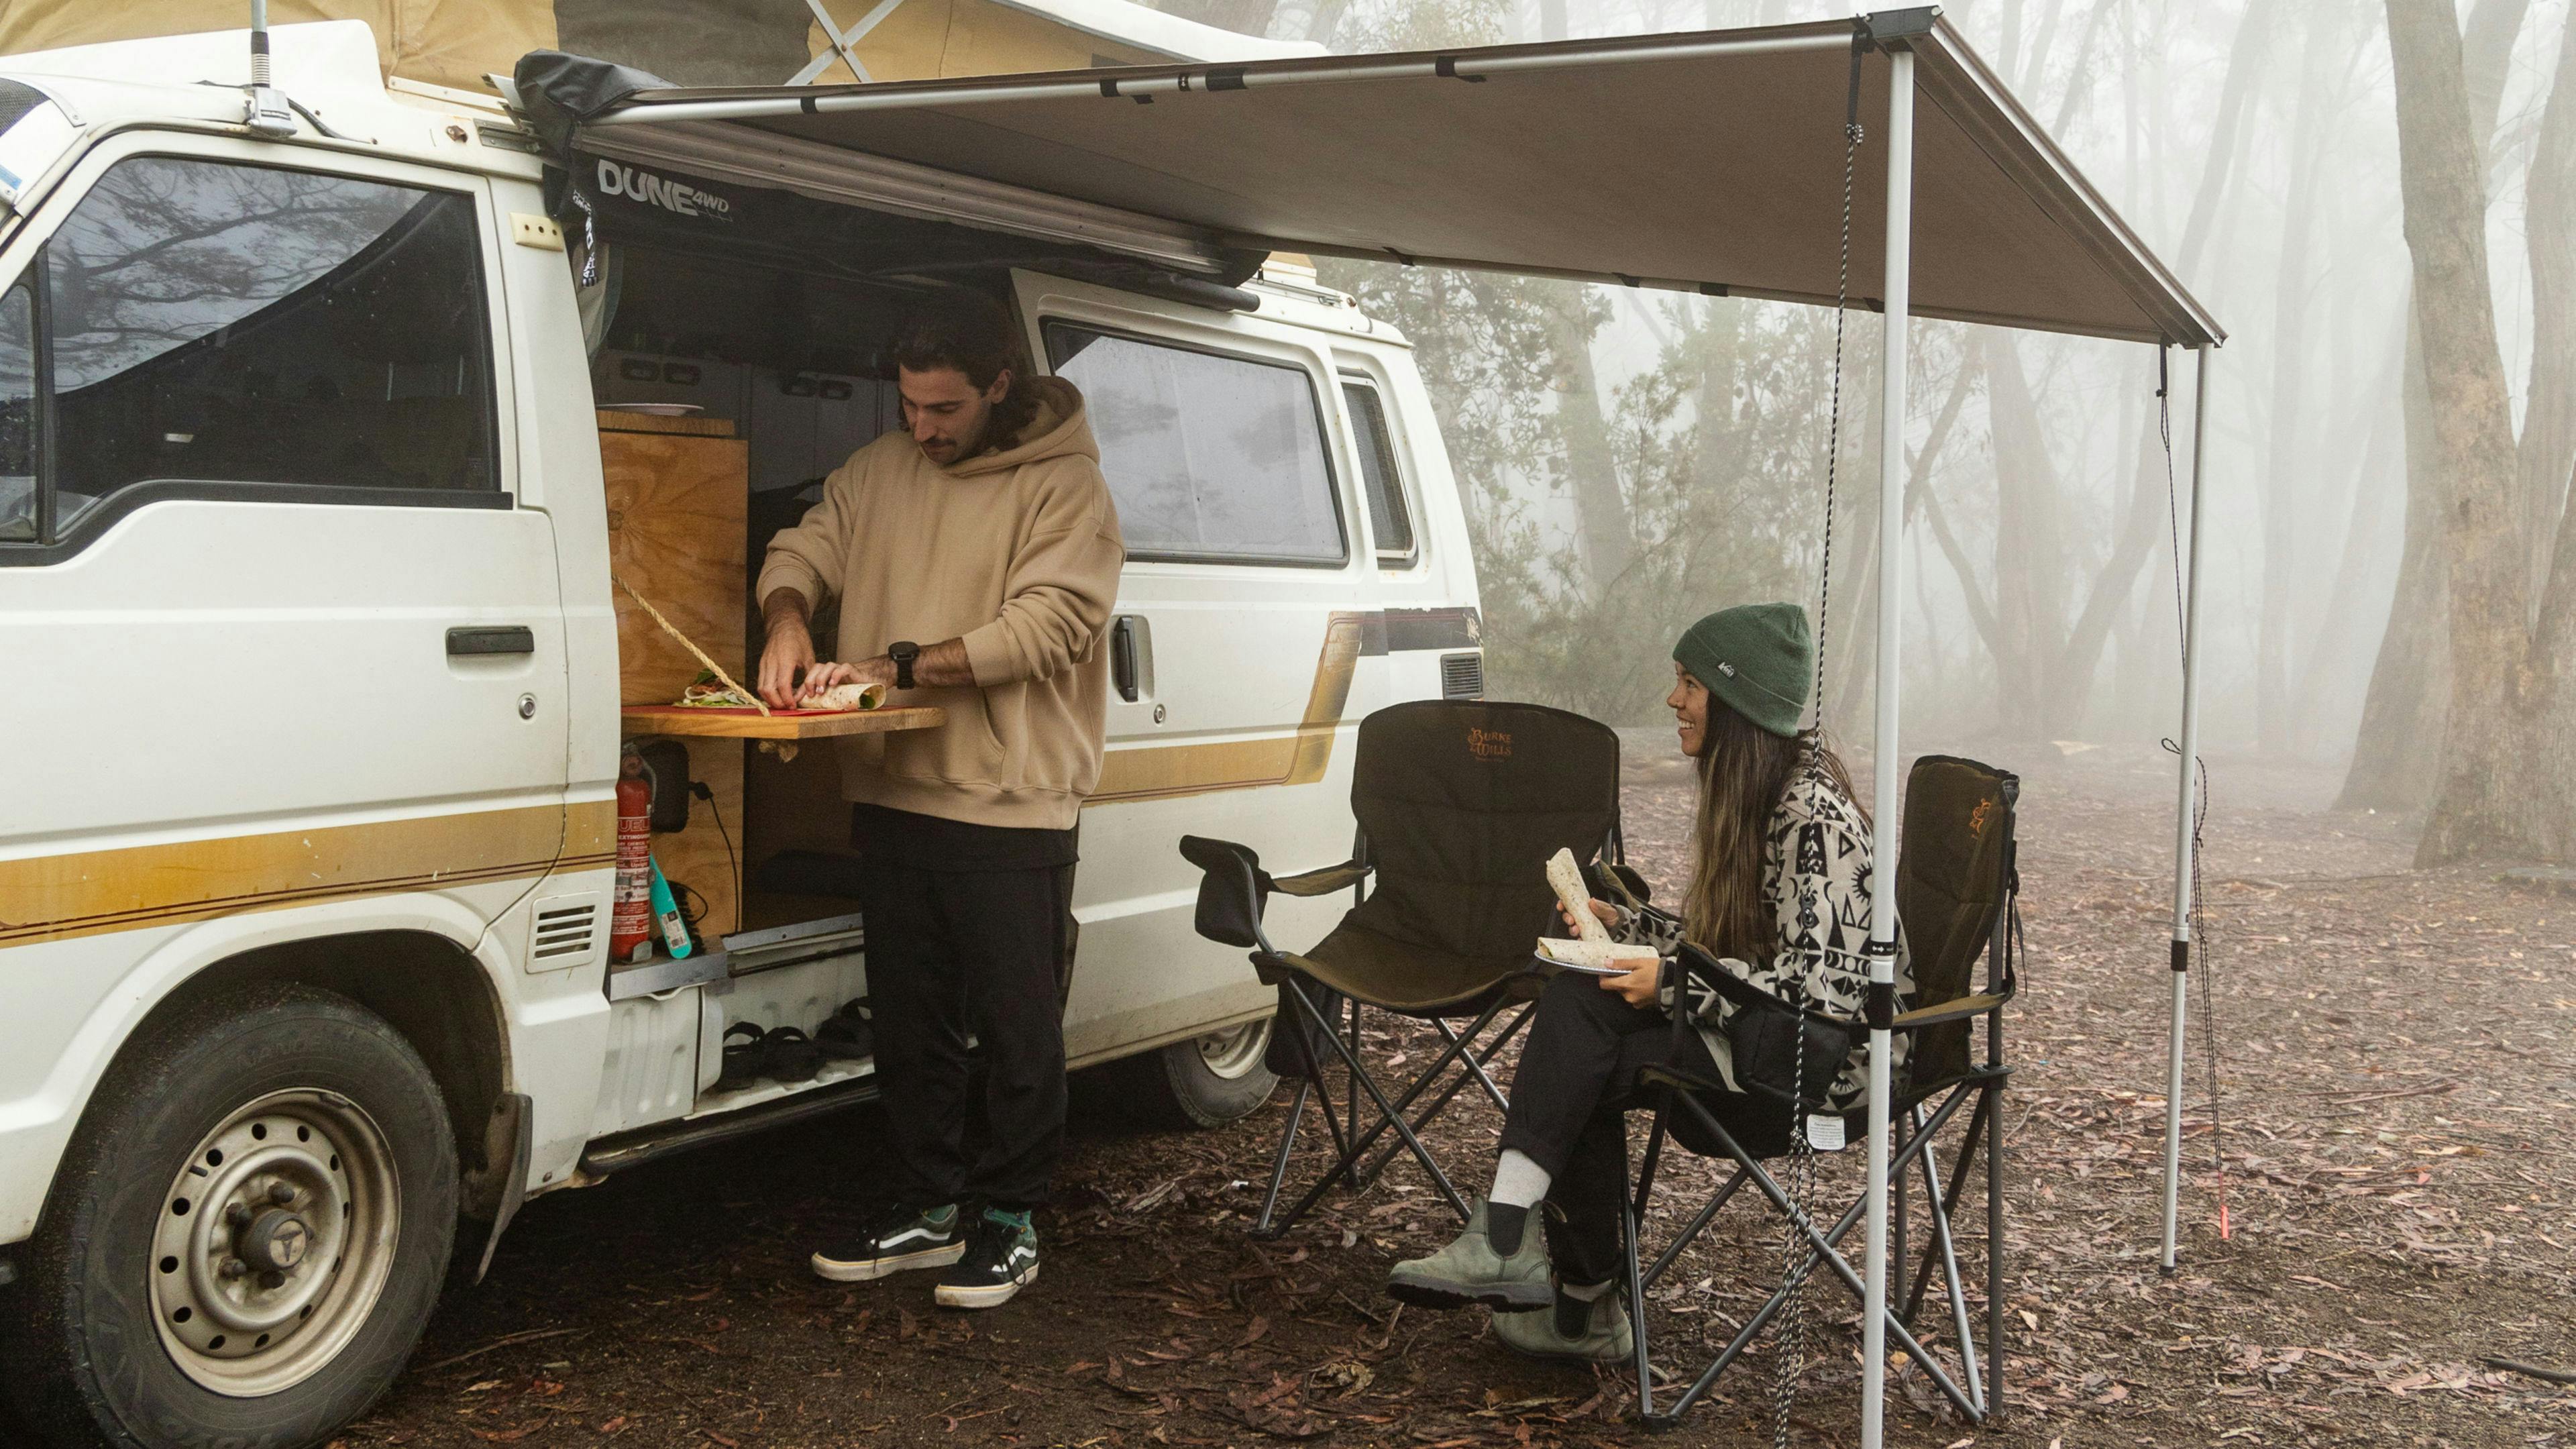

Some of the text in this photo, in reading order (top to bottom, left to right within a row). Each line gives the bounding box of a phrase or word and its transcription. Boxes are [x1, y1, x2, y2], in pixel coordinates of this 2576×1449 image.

[598, 159, 729, 216] DUNE 4WD
[1468, 728, 1511, 744] BURKE
[1477, 743, 1512, 756] WILLS
